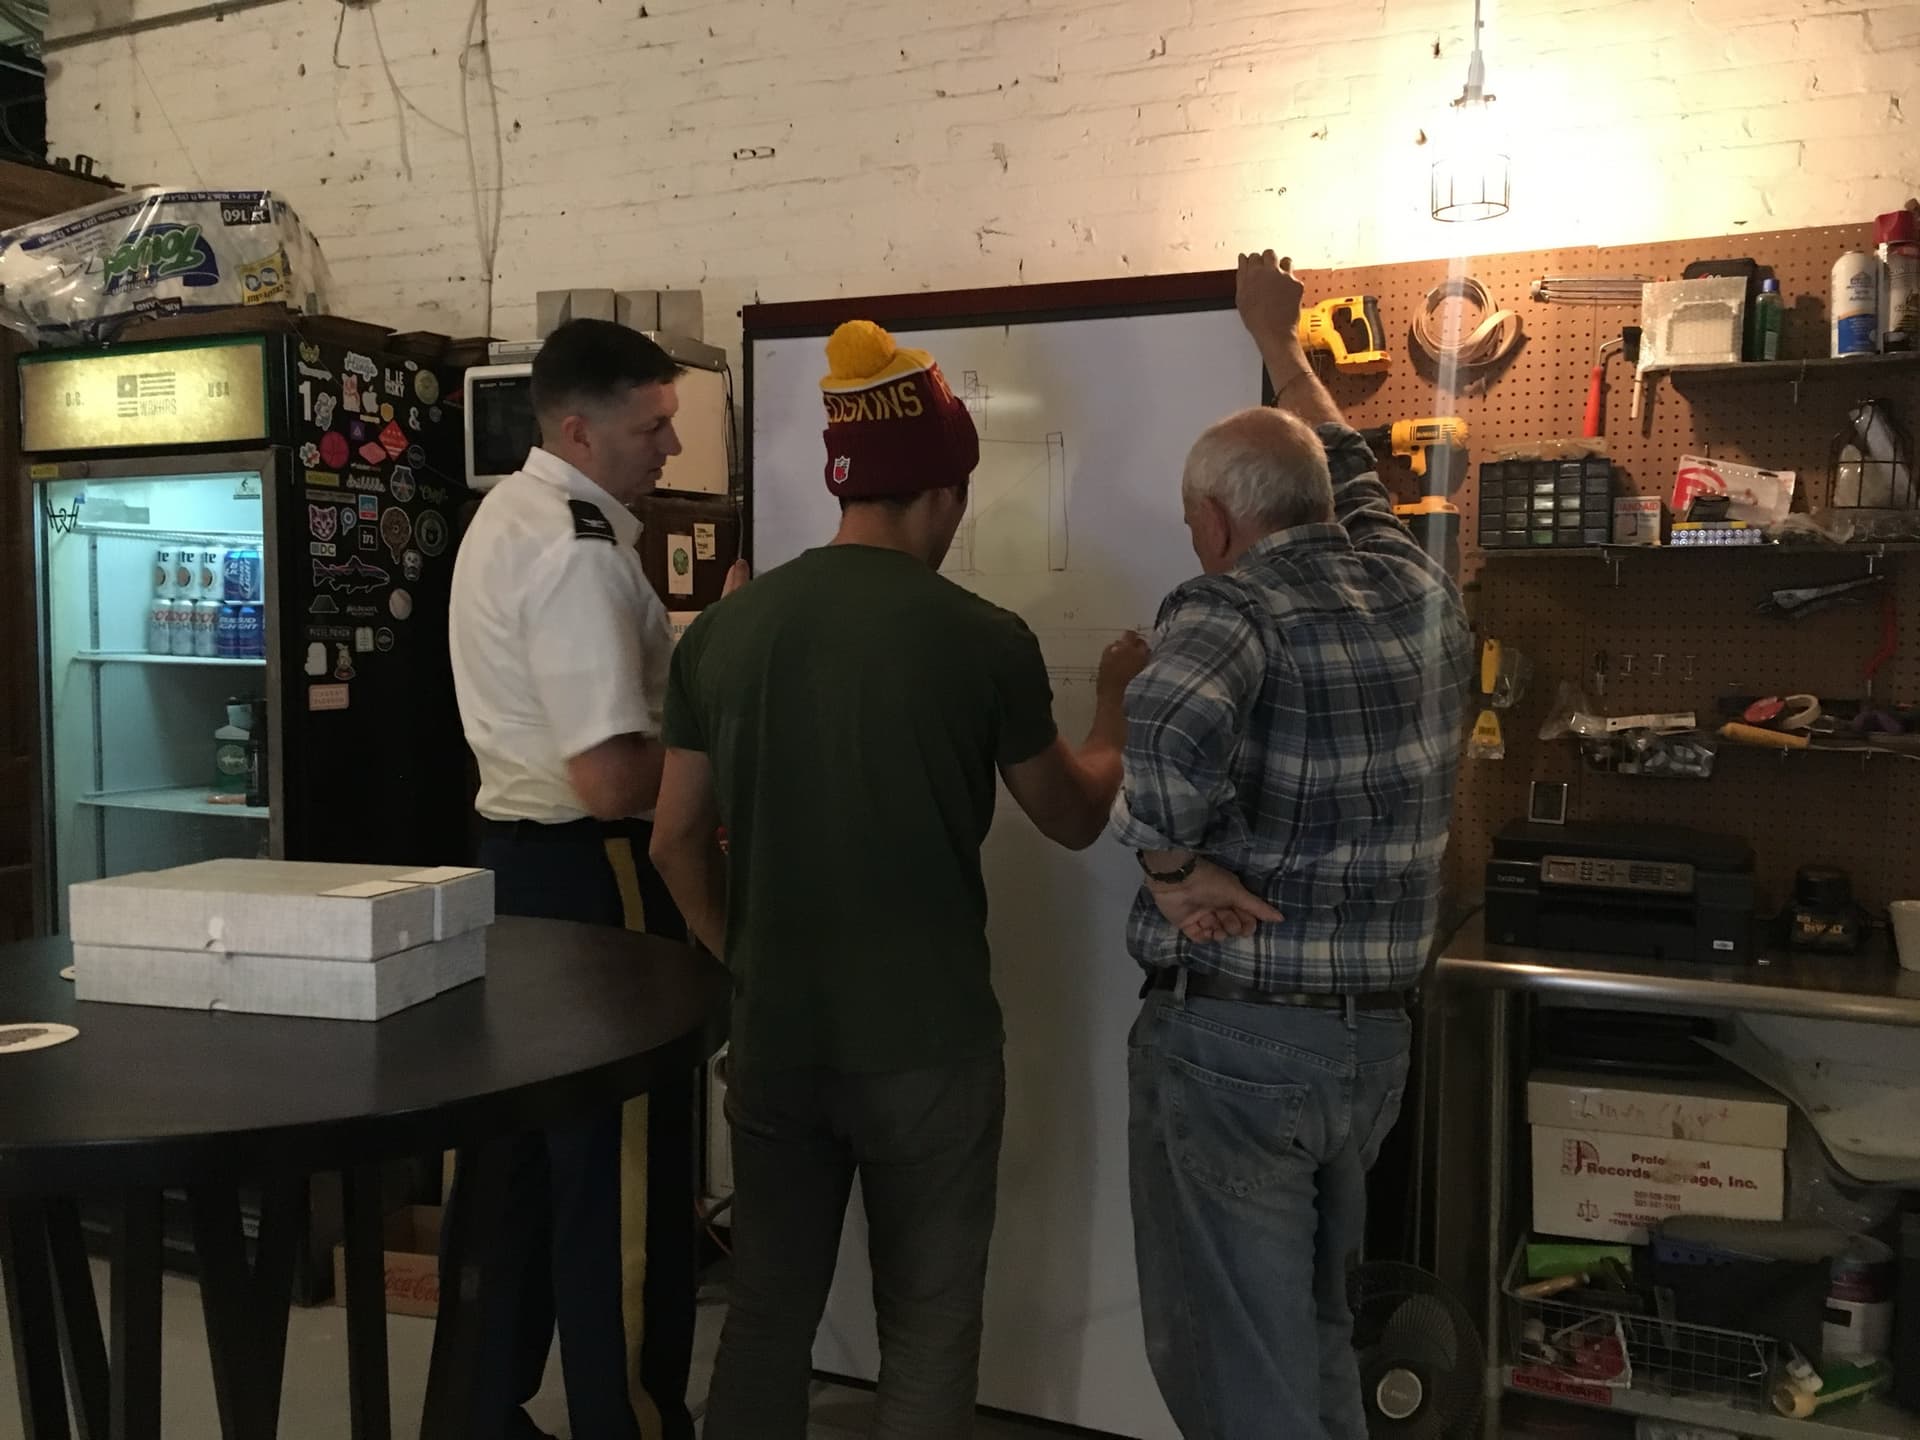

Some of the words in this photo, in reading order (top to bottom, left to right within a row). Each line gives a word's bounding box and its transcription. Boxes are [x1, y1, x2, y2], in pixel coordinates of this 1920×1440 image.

[223, 208, 248, 223] 160
[207, 381, 230, 398] USA
[824, 381, 924, 424] EDSKINS
[320, 544, 335, 555] DC
[1586, 1163, 1651, 1180] Records
[1728, 1174, 1758, 1191] Inc.
